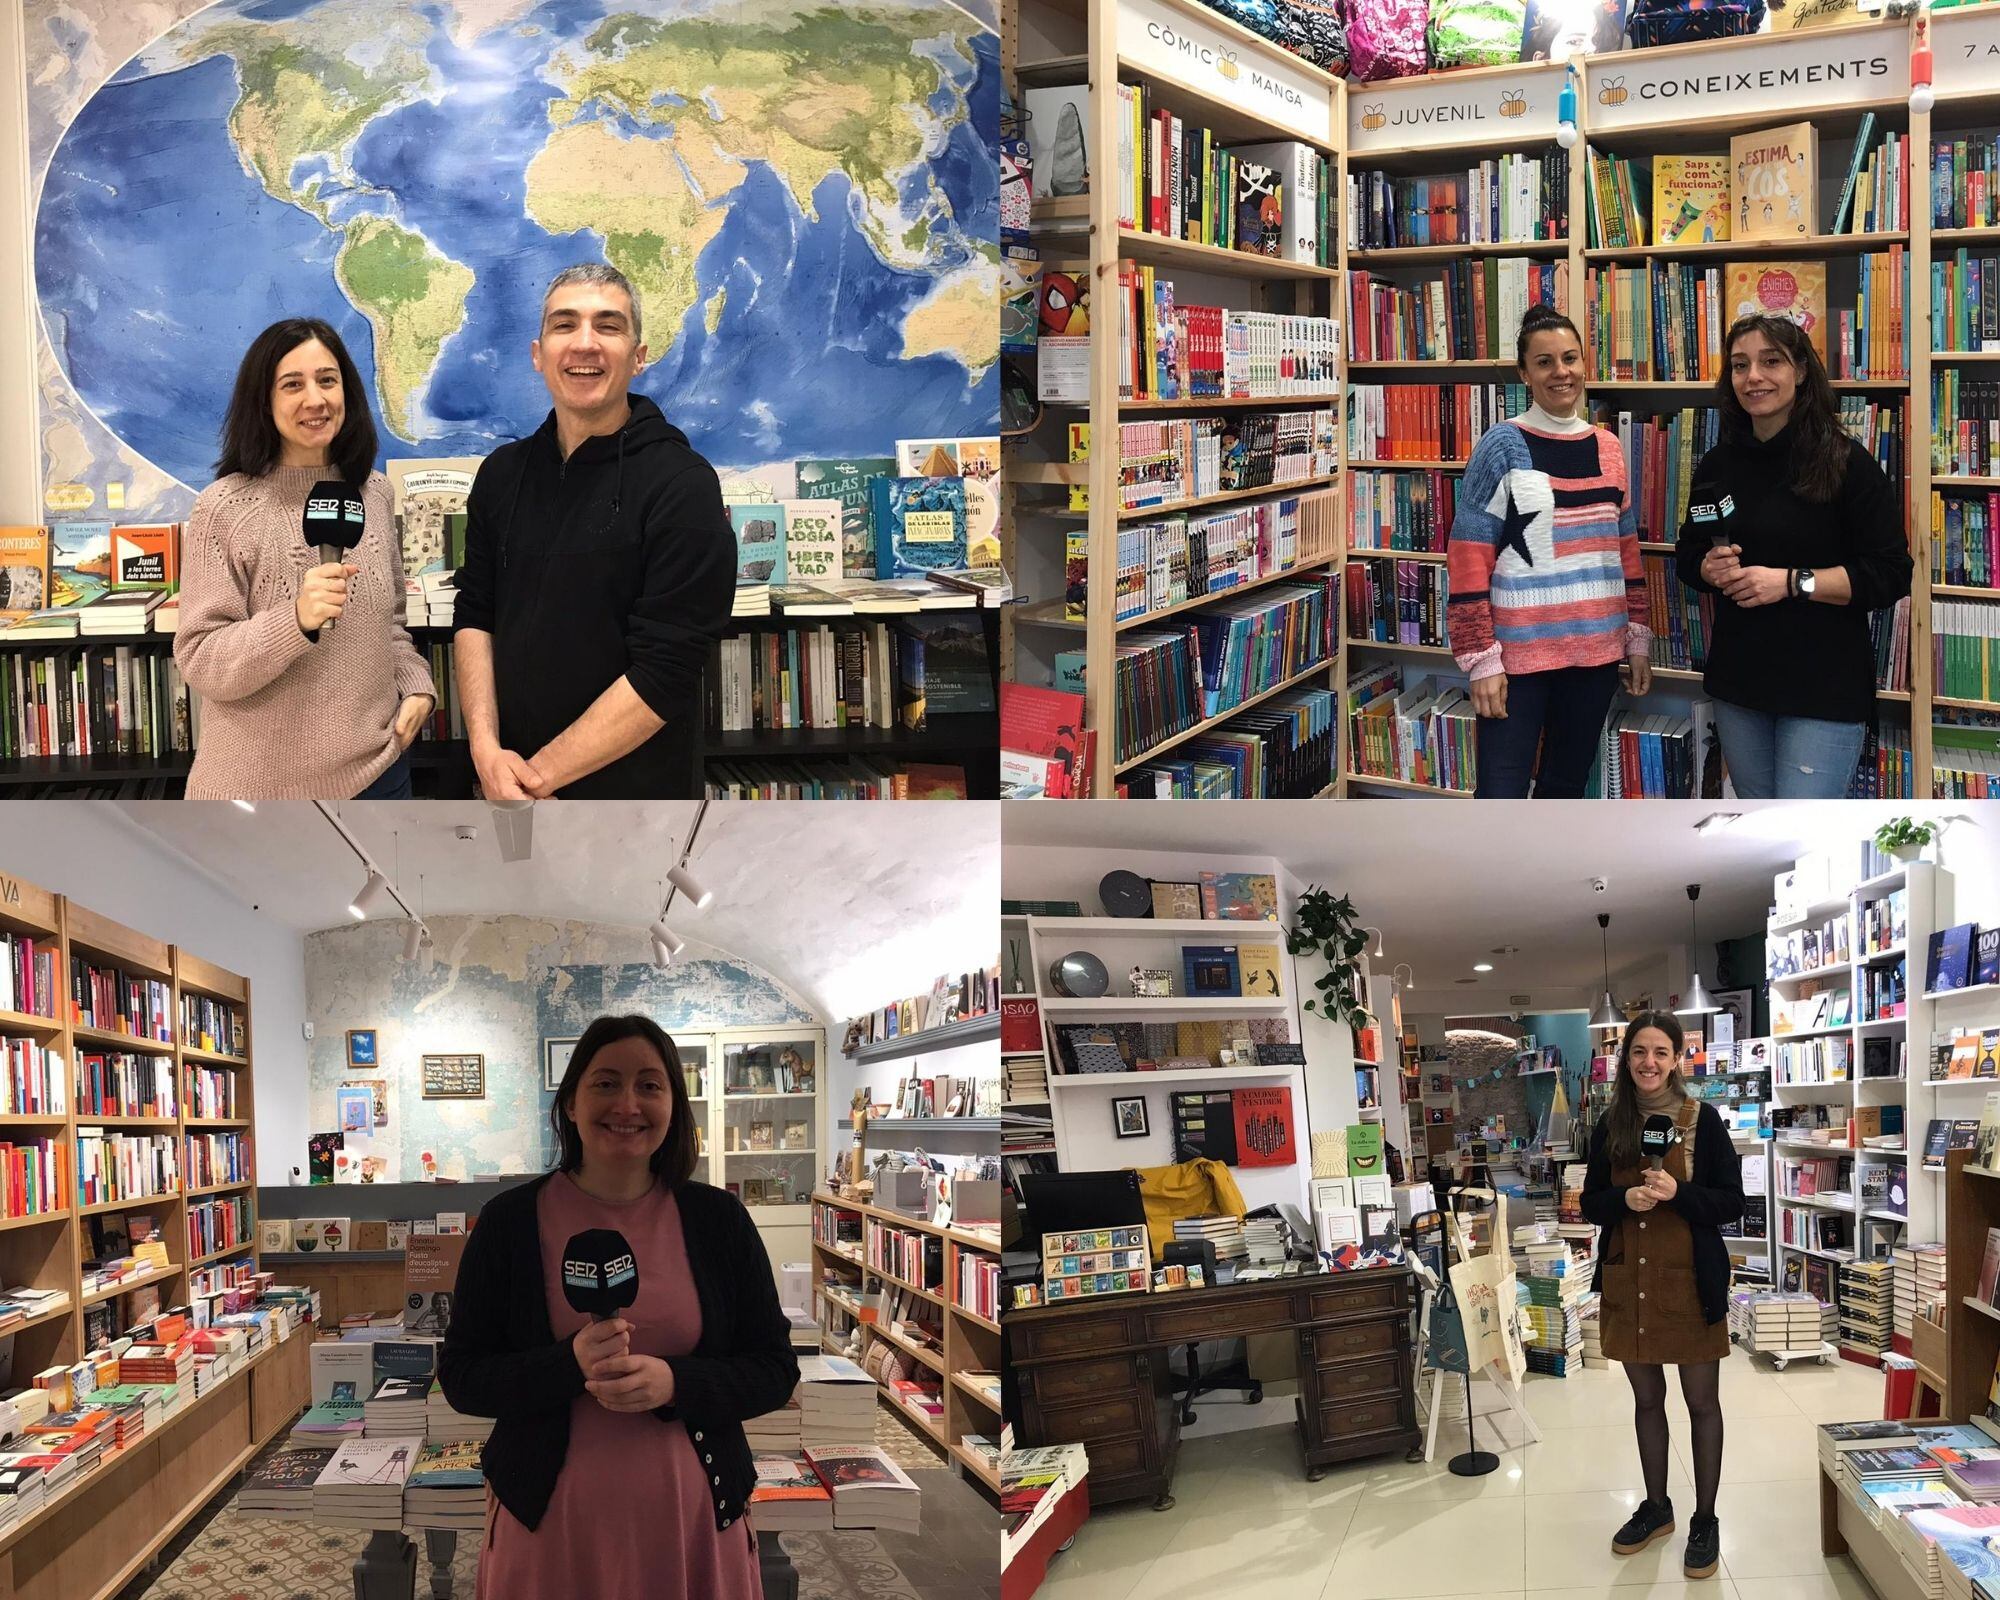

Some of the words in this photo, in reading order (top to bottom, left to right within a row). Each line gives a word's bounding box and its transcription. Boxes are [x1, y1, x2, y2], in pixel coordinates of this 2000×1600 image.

[1147, 21, 1212, 65] CÒMIC
[1964, 44, 1977, 58] 7
[1640, 57, 1888, 100] CONEIXEMENTS
[1251, 71, 1304, 108] MANGA
[1391, 104, 1485, 126] JUVENIL
[1745, 145, 1796, 166] ESTIMA
[1685, 160, 1710, 171] Saps
[1684, 171, 1710, 179] com
[1668, 179, 1723, 190] funciona?
[809, 478, 858, 499] ATLAS
[307, 499, 339, 511] SER
[343, 500, 363, 514] SER
[1719, 494, 1733, 511] SER
[1690, 504, 1717, 516] SER
[793, 518, 828, 530] ECO
[785, 529, 835, 542] LOGÍA
[137, 556, 158, 566] Junil
[787, 550, 834, 563] LIBER
[143, 565, 161, 573] terres
[795, 564, 827, 575] TAD
[846, 633, 862, 680] METROPOLIS
[1978, 931, 1999, 951] 100
[1644, 1130, 1664, 1139] SER
[410, 1245, 440, 1253] Domingo
[564, 1260, 597, 1279] SER
[603, 1254, 634, 1278] SER
[253, 1466, 286, 1477] QUE
[268, 1461, 300, 1469] SAP
